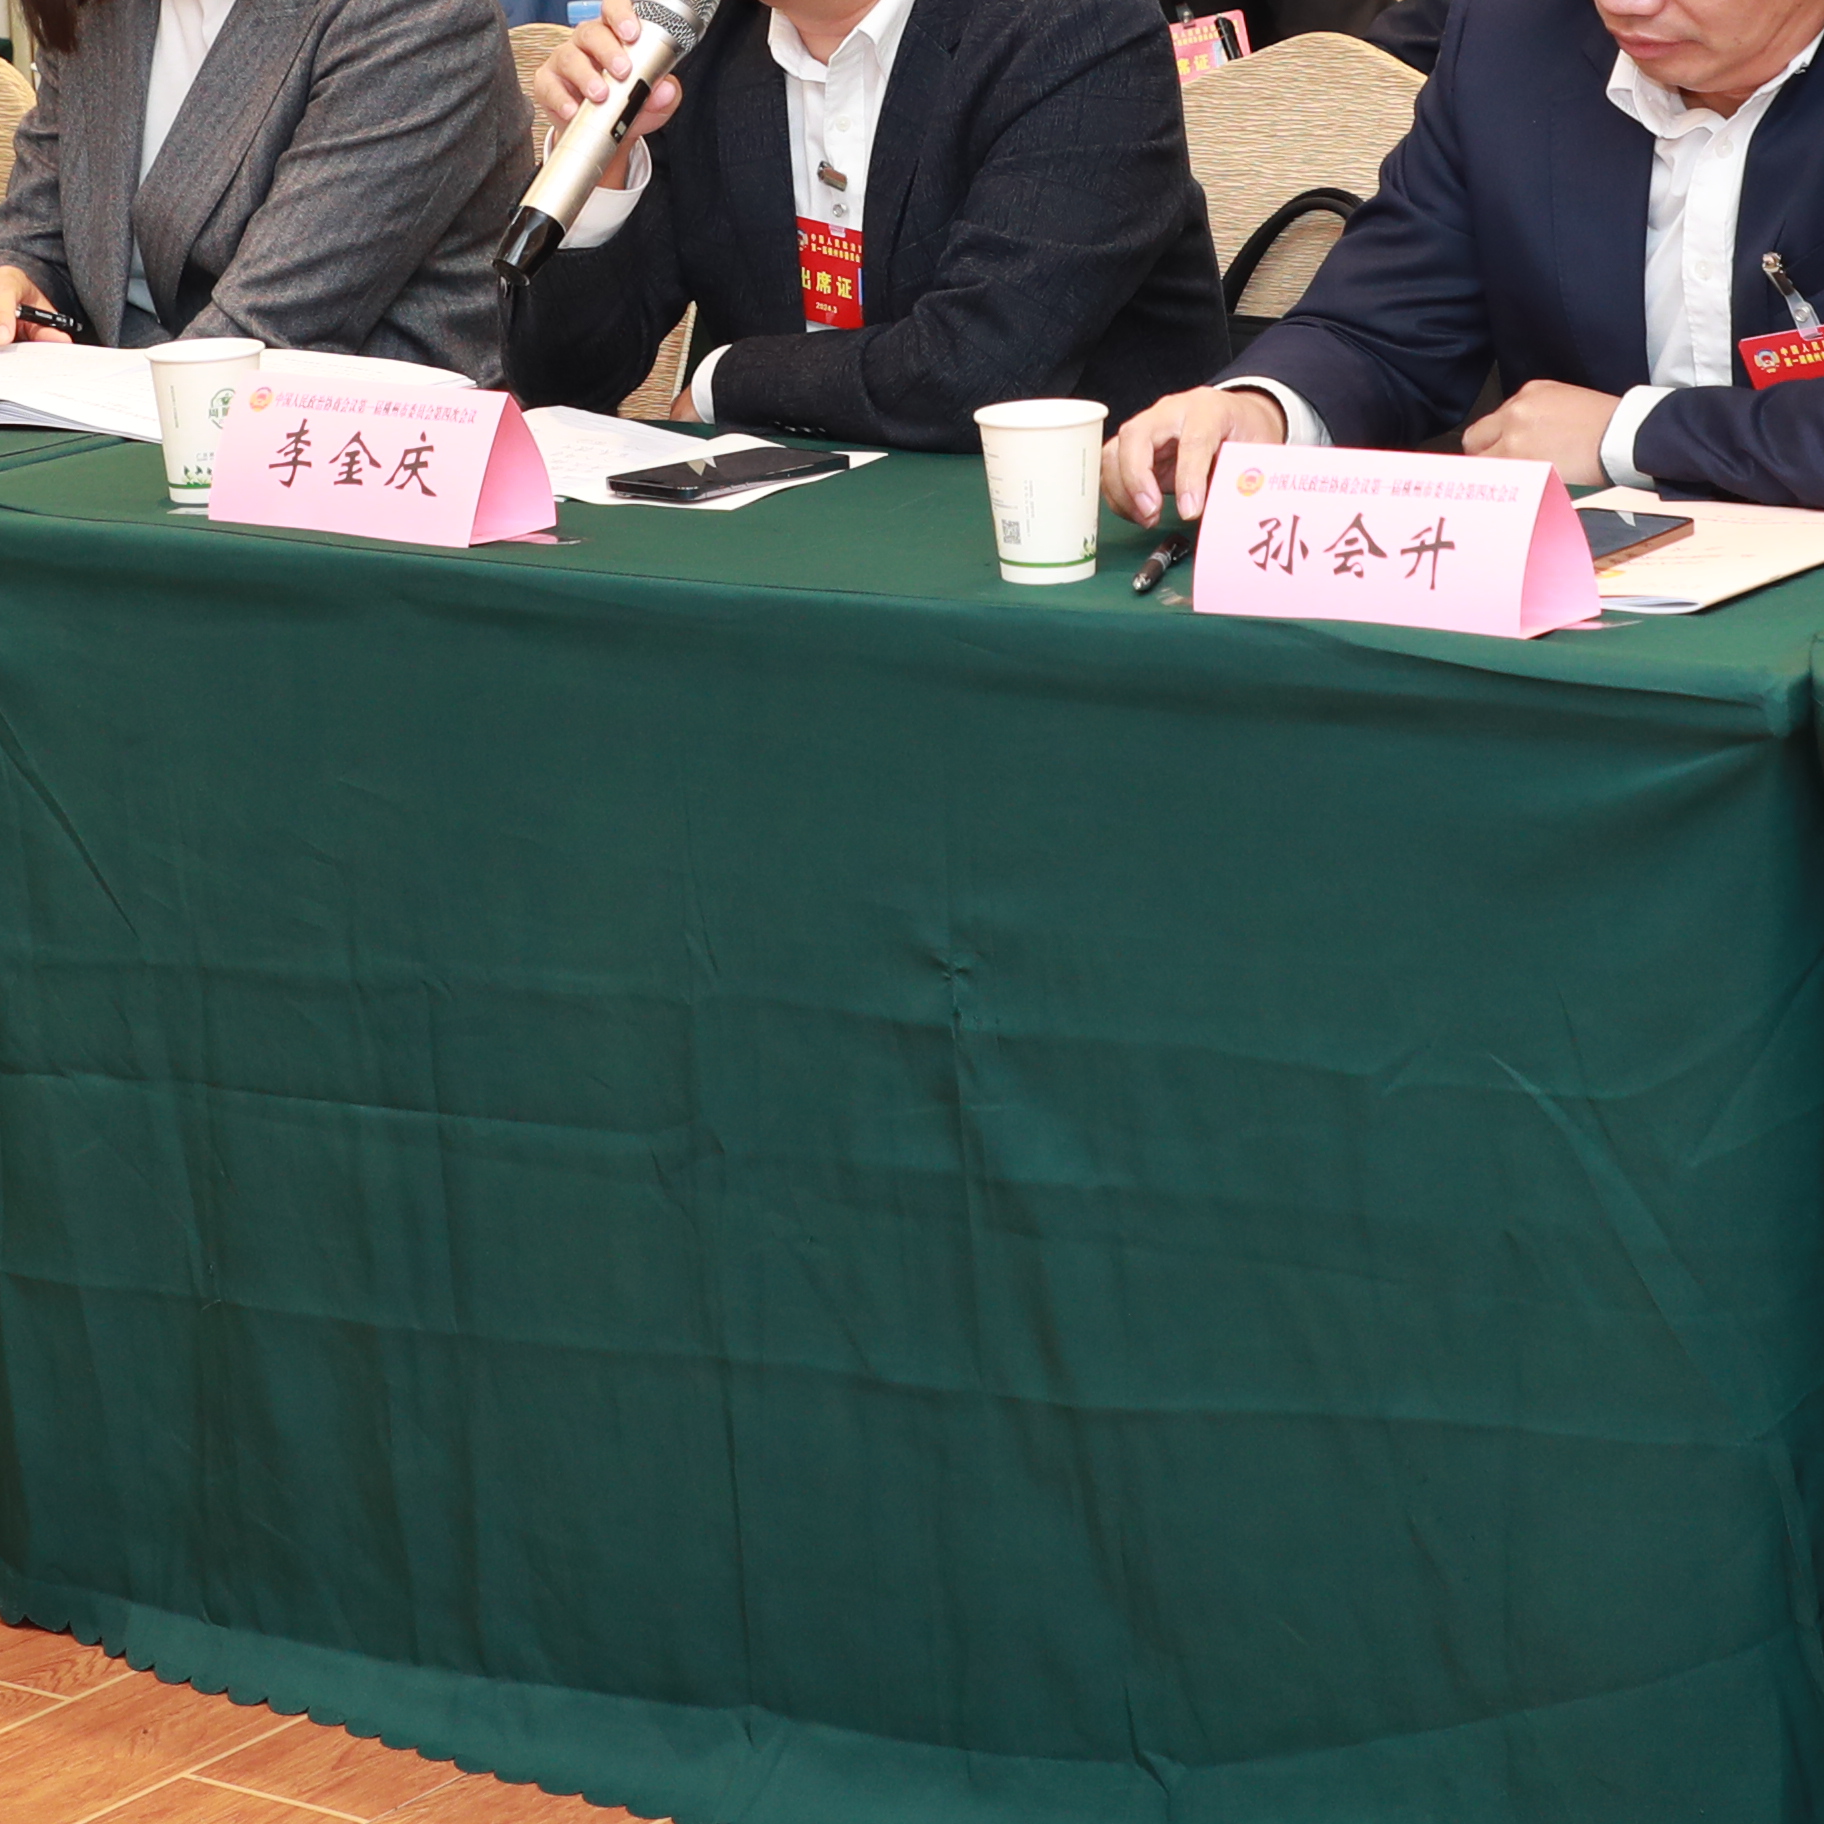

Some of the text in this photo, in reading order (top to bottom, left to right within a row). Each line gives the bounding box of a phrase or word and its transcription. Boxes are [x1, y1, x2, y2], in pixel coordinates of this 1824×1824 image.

[801, 267, 853, 299] 出席证
[269, 418, 437, 496] 李金庆
[1248, 512, 1455, 590] 孙会升
